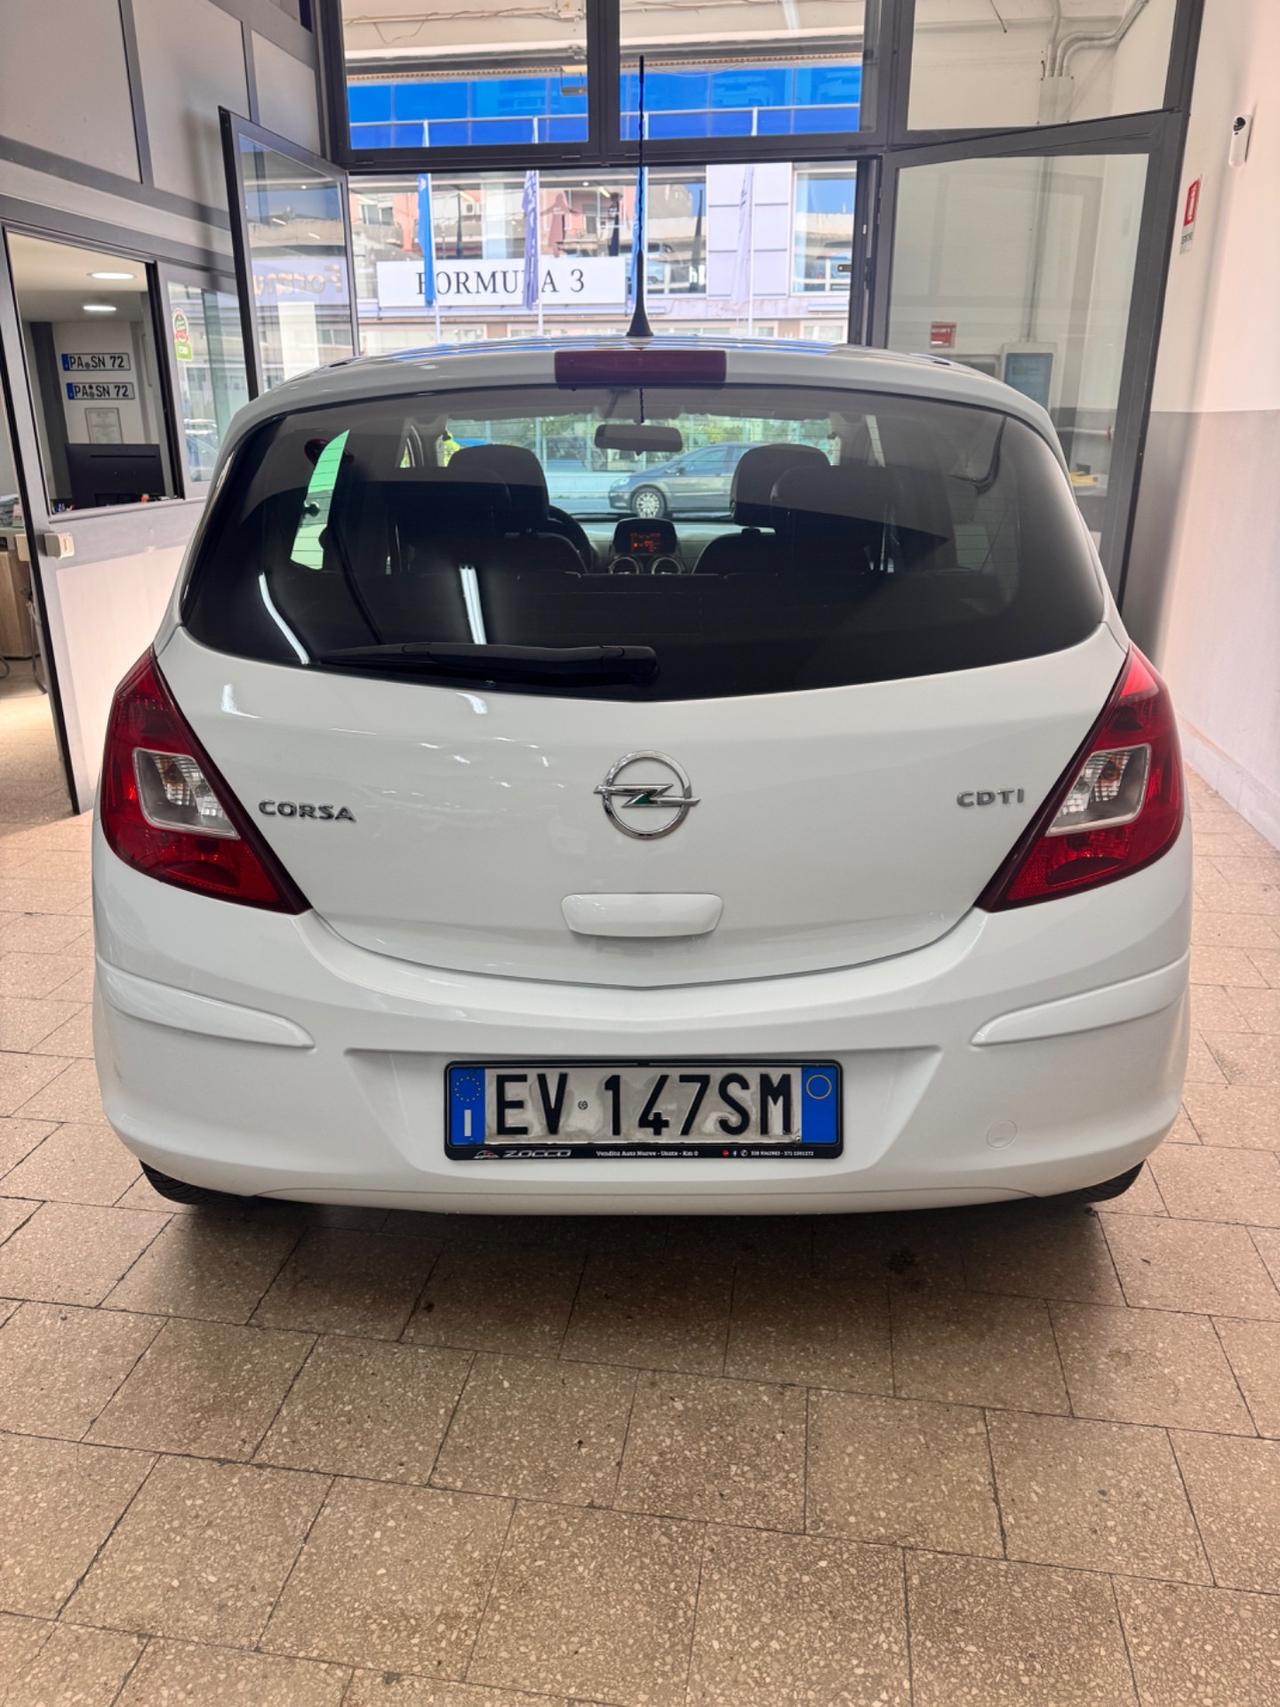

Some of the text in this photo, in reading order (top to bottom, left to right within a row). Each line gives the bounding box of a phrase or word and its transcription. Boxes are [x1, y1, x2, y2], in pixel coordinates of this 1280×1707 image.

[416, 268, 585, 295] FORMUA 3
[70, 355, 125, 369] PA SN 72
[74, 385, 129, 397] PA SN 72
[957, 788, 1024, 808] CDTI
[258, 800, 356, 822] CORSA
[496, 1073, 792, 1136] EV 147SM
[502, 1149, 572, 1158] ZOCCO
